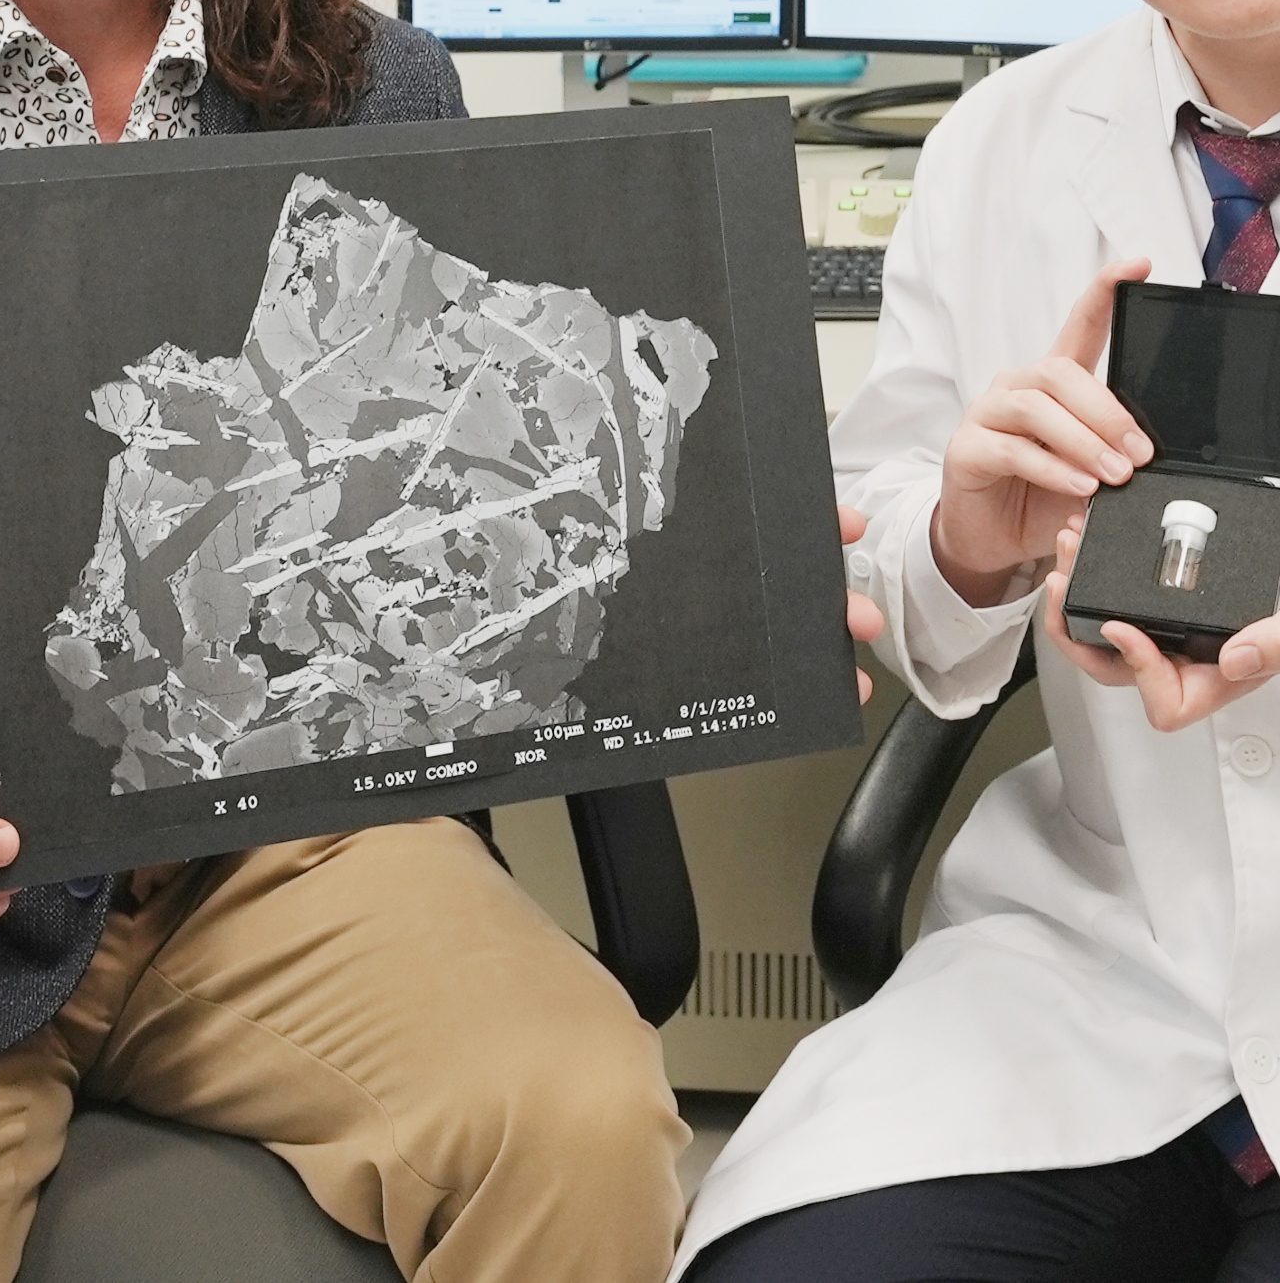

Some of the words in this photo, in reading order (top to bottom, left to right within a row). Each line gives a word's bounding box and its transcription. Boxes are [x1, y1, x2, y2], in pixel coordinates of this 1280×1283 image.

[592, 714, 633, 733] JEOL
[679, 694, 756, 719] 8/1/2023
[214, 799, 228, 816] X
[237, 795, 258, 811] 40
[353, 769, 417, 792] 15.0kV
[425, 760, 478, 781] COMPO
[514, 748, 548, 765] NOR
[603, 734, 625, 751] WD
[633, 725, 694, 746] 11.4mm
[700, 709, 776, 735] 14:47:00
